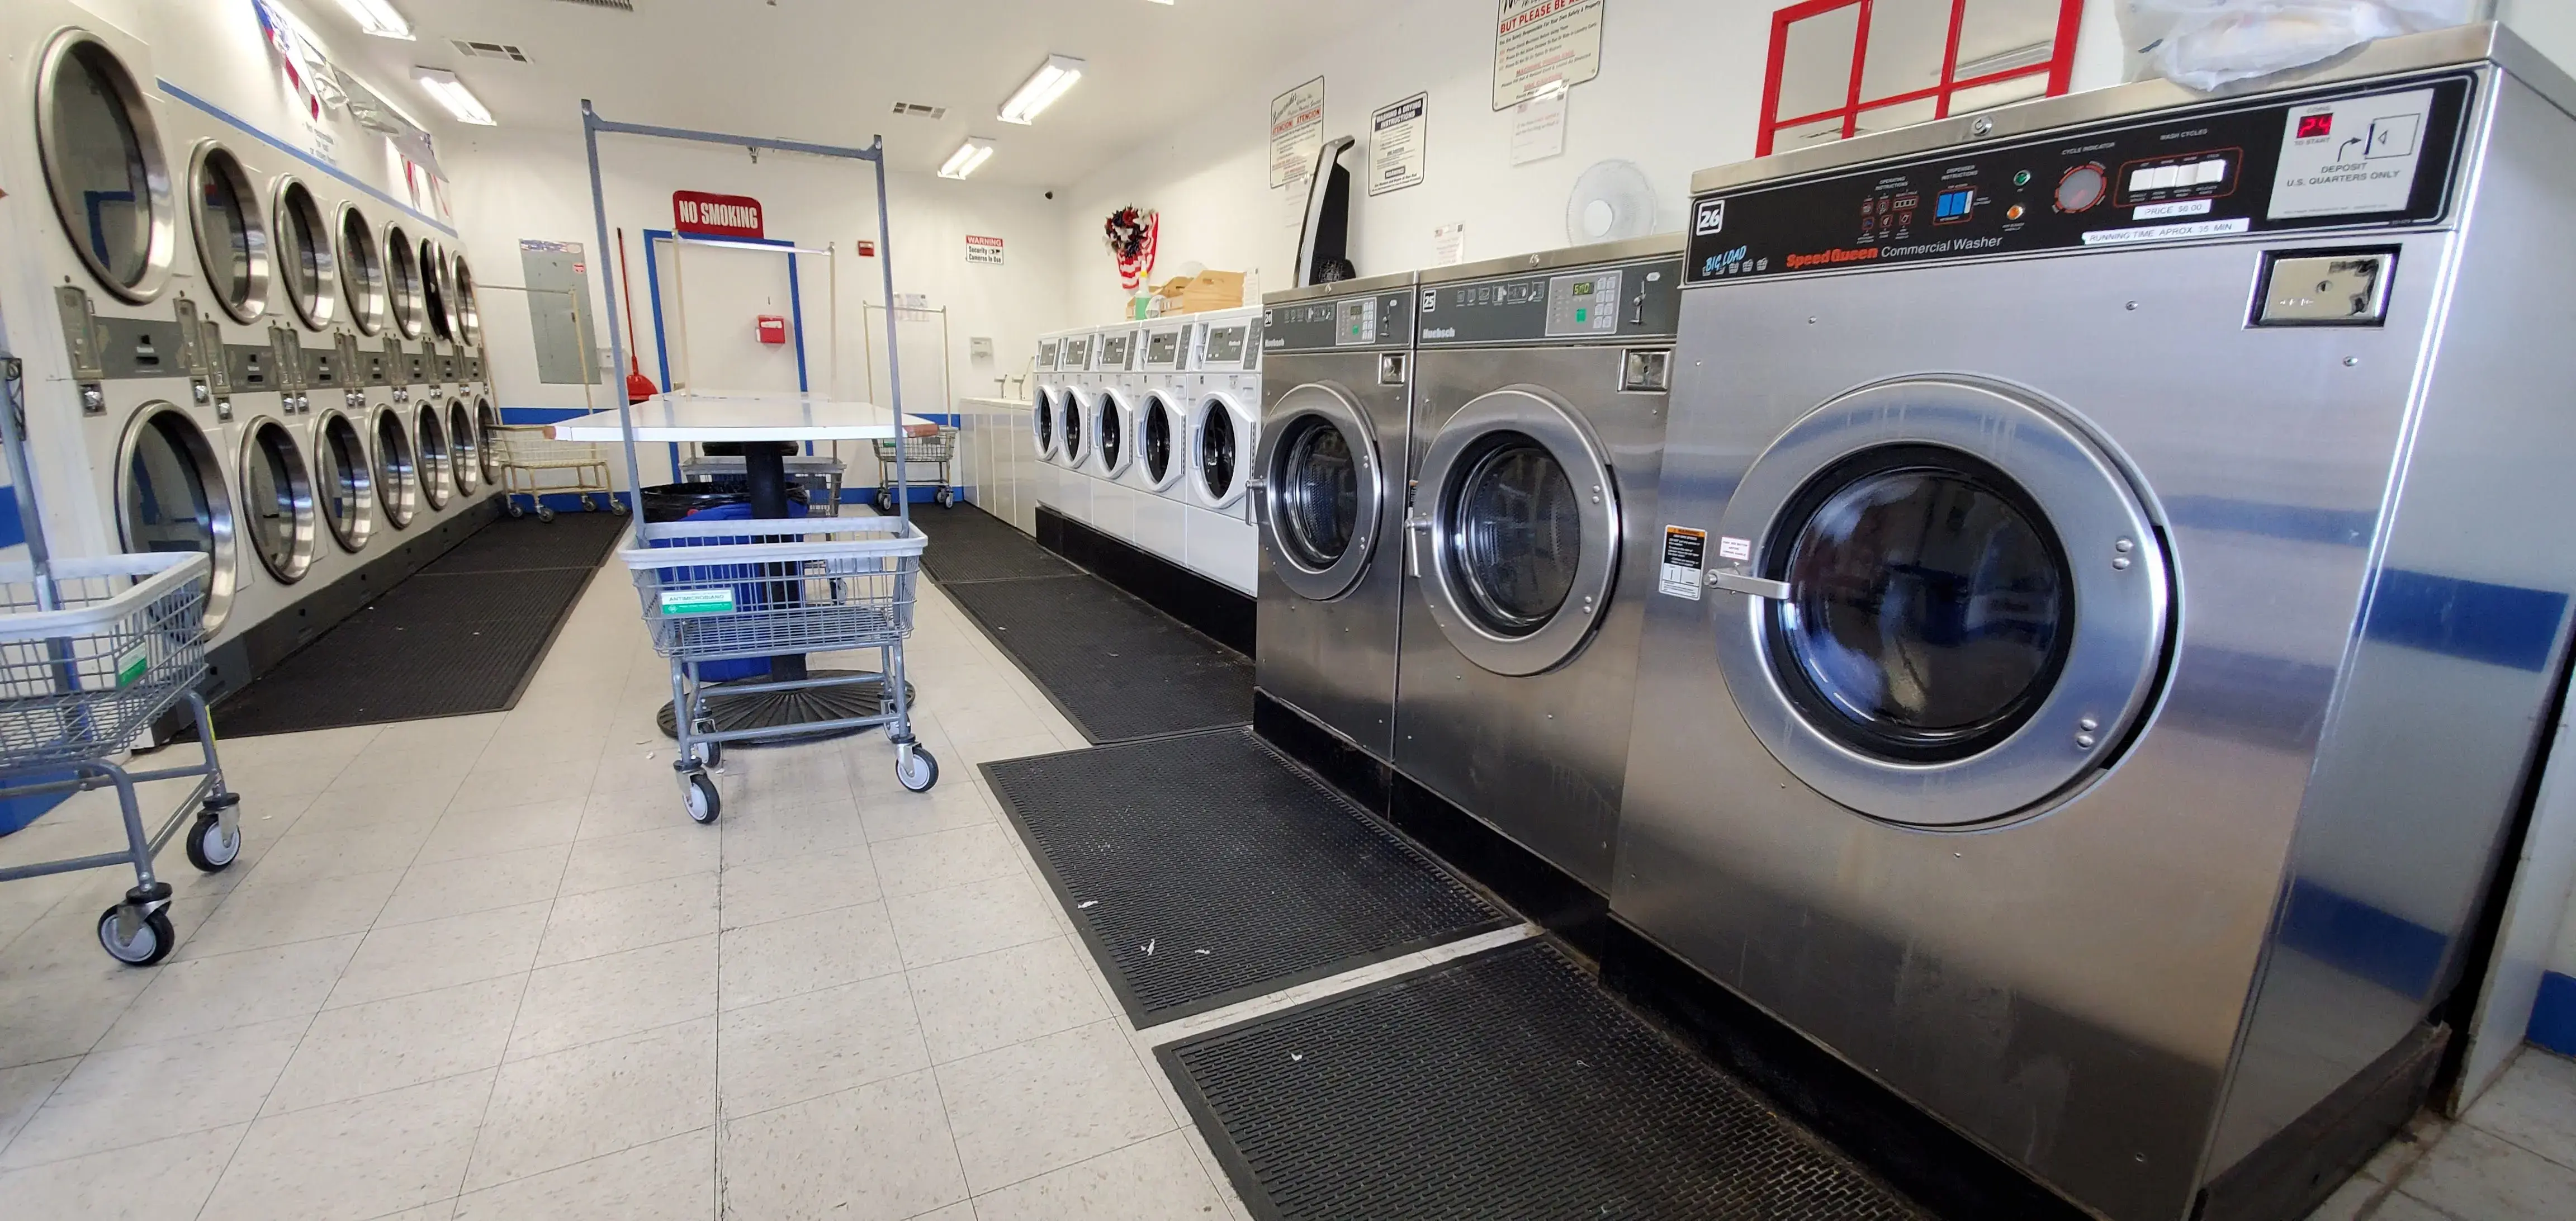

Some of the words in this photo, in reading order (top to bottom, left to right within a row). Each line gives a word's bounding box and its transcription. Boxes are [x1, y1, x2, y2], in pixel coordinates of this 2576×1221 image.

[1500, 17, 1517, 34] BUT
[1519, 2, 1551, 26] PLEASE
[1555, 0, 1565, 10] BE
[1380, 109, 1415, 129] INSTRUCTIONS
[2181, 128, 2208, 138] CYCLES
[2321, 162, 2367, 174] DEPOSIT
[1941, 170, 1979, 181] INSTRUCTIONS
[2287, 179, 2306, 187] U.S.
[2309, 173, 2367, 185] QUARTERS
[2370, 170, 2400, 179] ONLY
[679, 200, 699, 224] NO
[700, 202, 758, 229] SMOKING
[2144, 206, 2173, 215] PRICE
[1700, 209, 1720, 228] 26
[968, 236, 1002, 246] WARNING
[2089, 231, 2130, 242] RUNNING
[2133, 230, 2153, 239] TIME
[969, 245, 987, 255] Security
[1881, 239, 1951, 258] Commercial
[1954, 235, 2003, 250] Washer
[969, 253, 987, 262] Cameras
[1705, 253, 1723, 273] BIG
[1722, 244, 1748, 266] LOAD
[1787, 248, 1831, 269] Speed
[1831, 247, 1878, 263] Queen
[1424, 295, 1434, 307] 25
